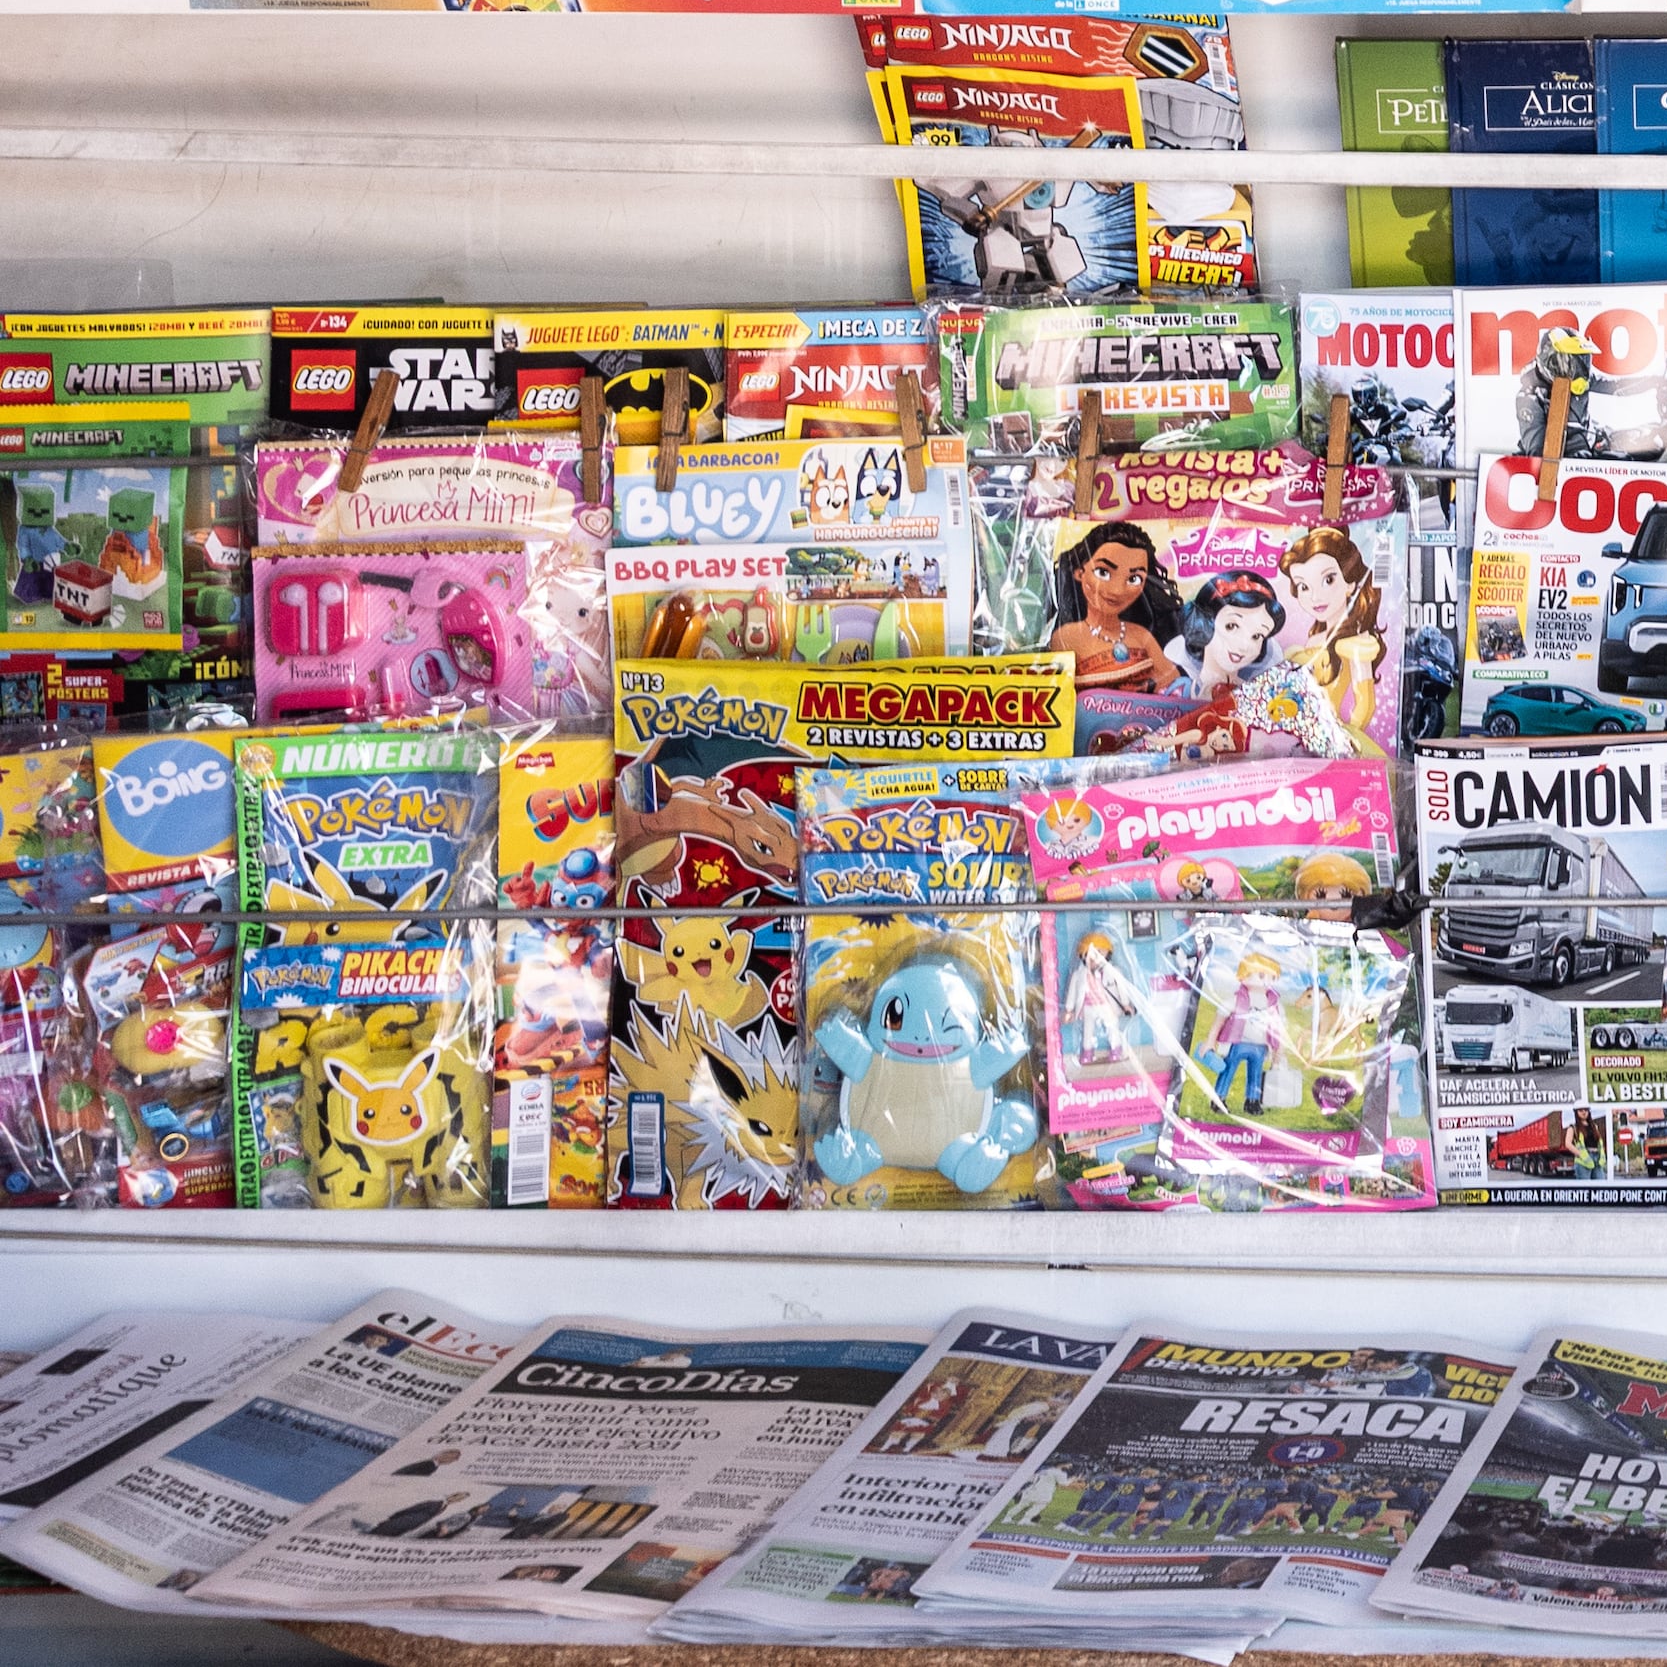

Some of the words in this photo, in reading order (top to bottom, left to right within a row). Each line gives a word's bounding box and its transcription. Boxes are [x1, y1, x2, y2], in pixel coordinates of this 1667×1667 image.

[941, 23, 1072, 56] NINJAGO
[64, 360, 260, 394] MINECRAFT
[625, 478, 782, 539] BLUEY
[615, 560, 670, 583] BBQ
[743, 557, 786, 577] SET
[799, 682, 1060, 728] MEGAPACK
[1118, 786, 1335, 849] playmobil
[1455, 764, 1652, 828] CAMIÓN
[1181, 1399, 1466, 1445] RESACA
